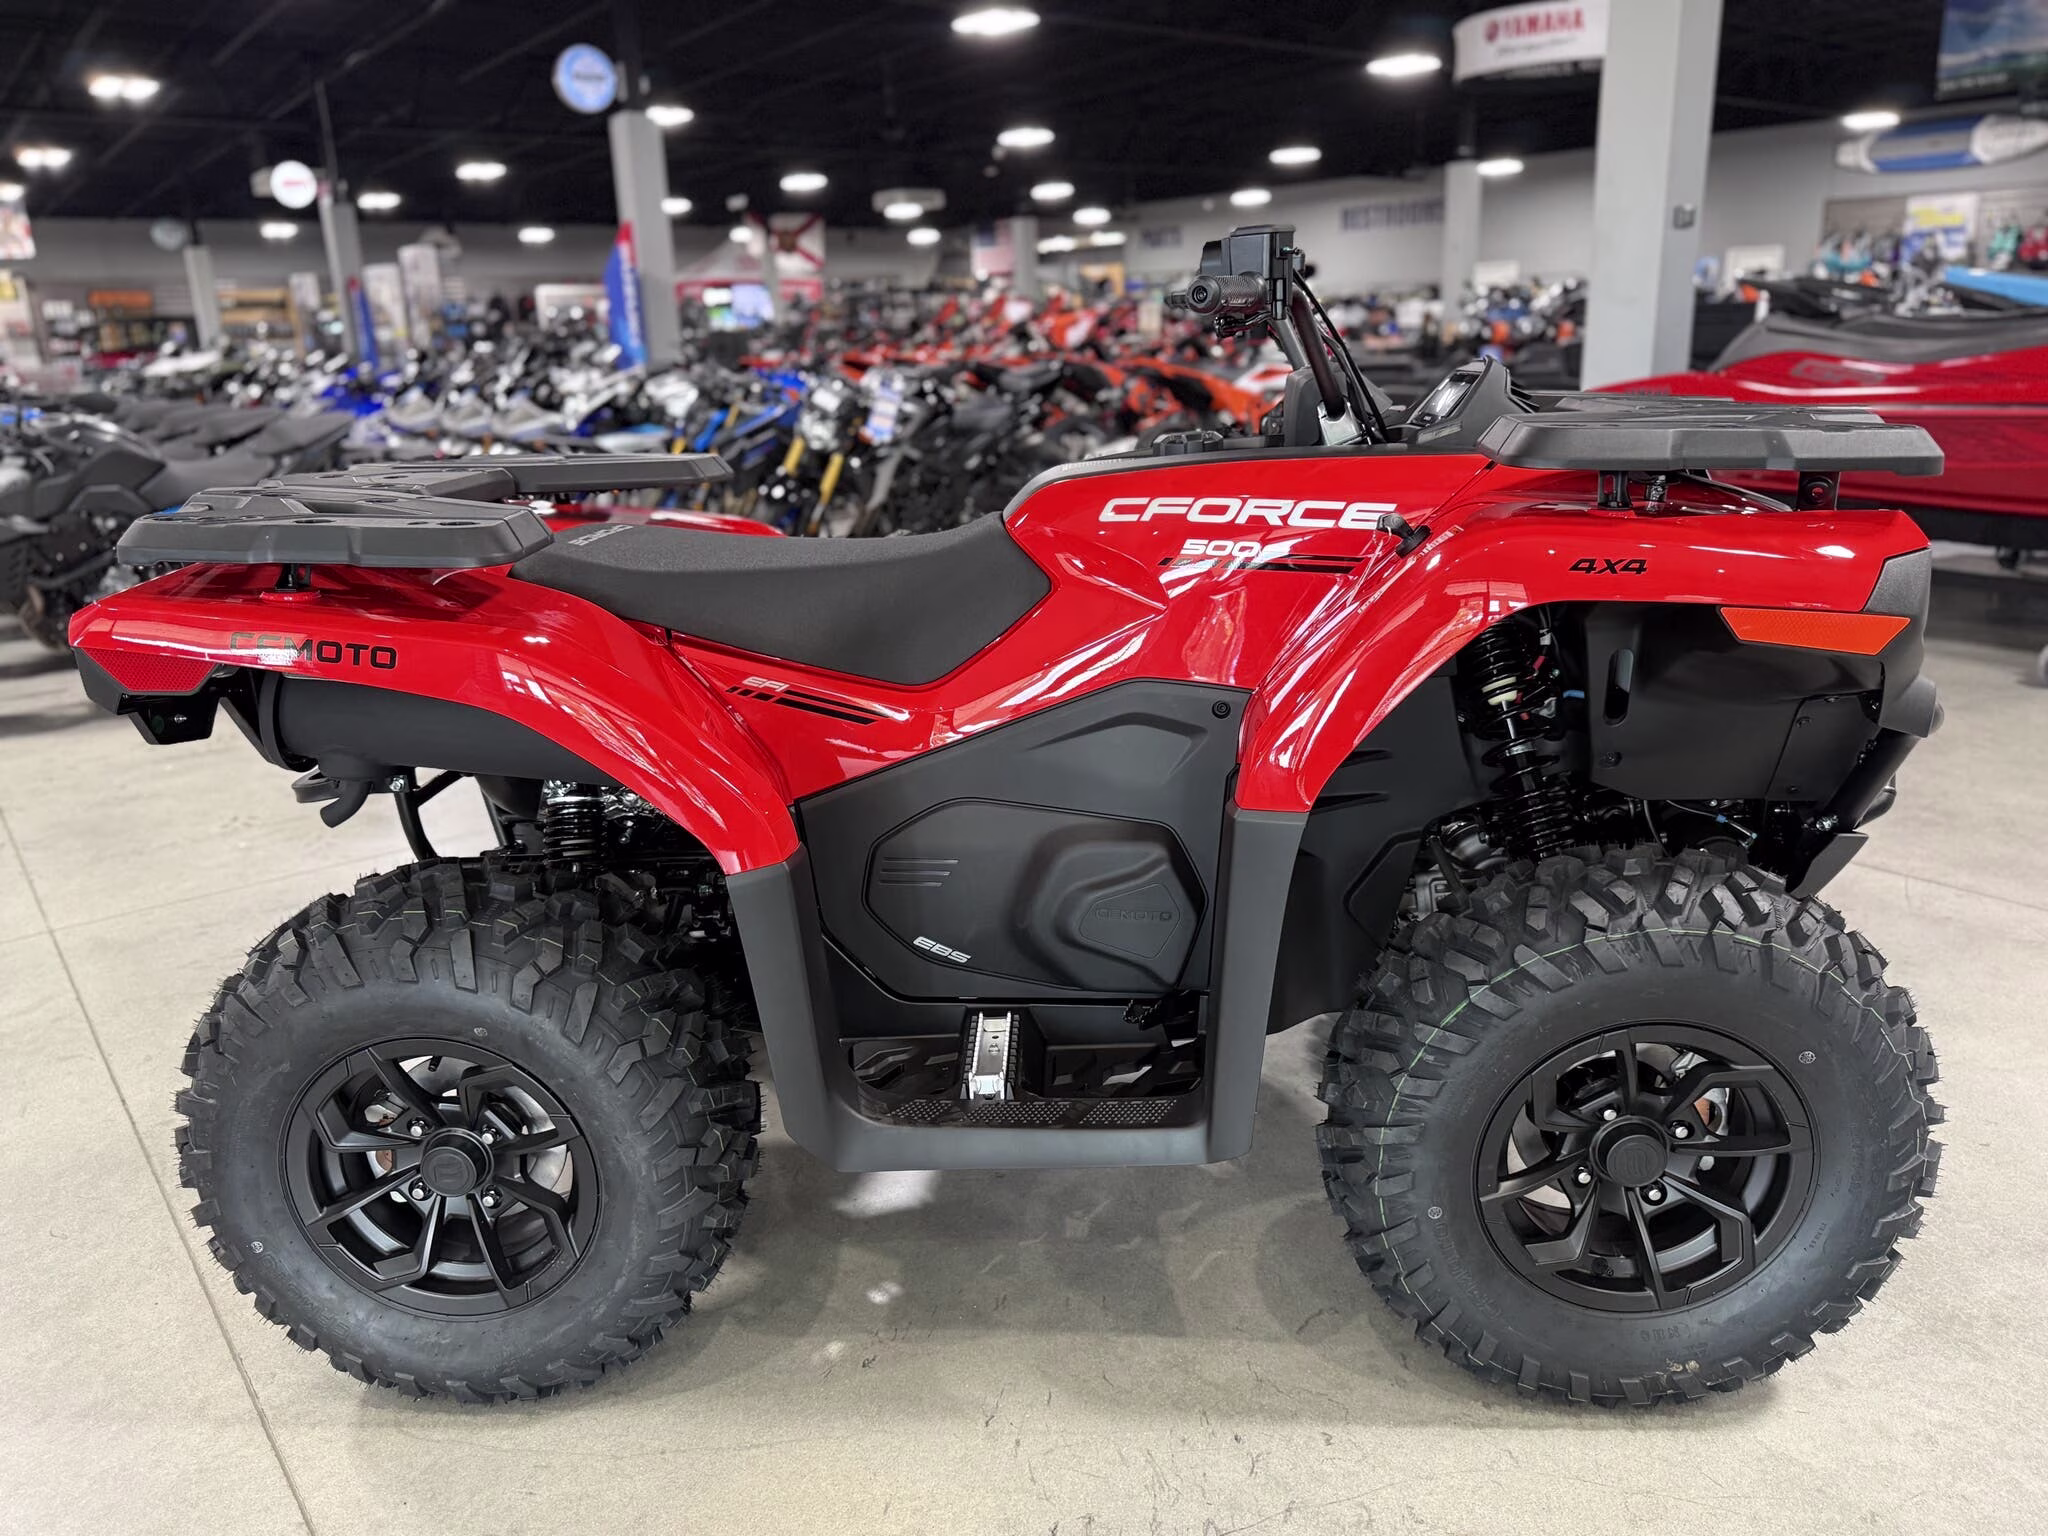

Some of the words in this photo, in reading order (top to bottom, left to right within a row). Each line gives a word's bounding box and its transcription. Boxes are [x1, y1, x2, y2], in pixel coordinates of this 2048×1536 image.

[1505, 7, 1585, 38] YAMAHA
[1098, 496, 1398, 530] CFORCE
[1181, 538, 1262, 558] 500
[742, 675, 790, 692] EFI
[913, 936, 972, 963] EBS
